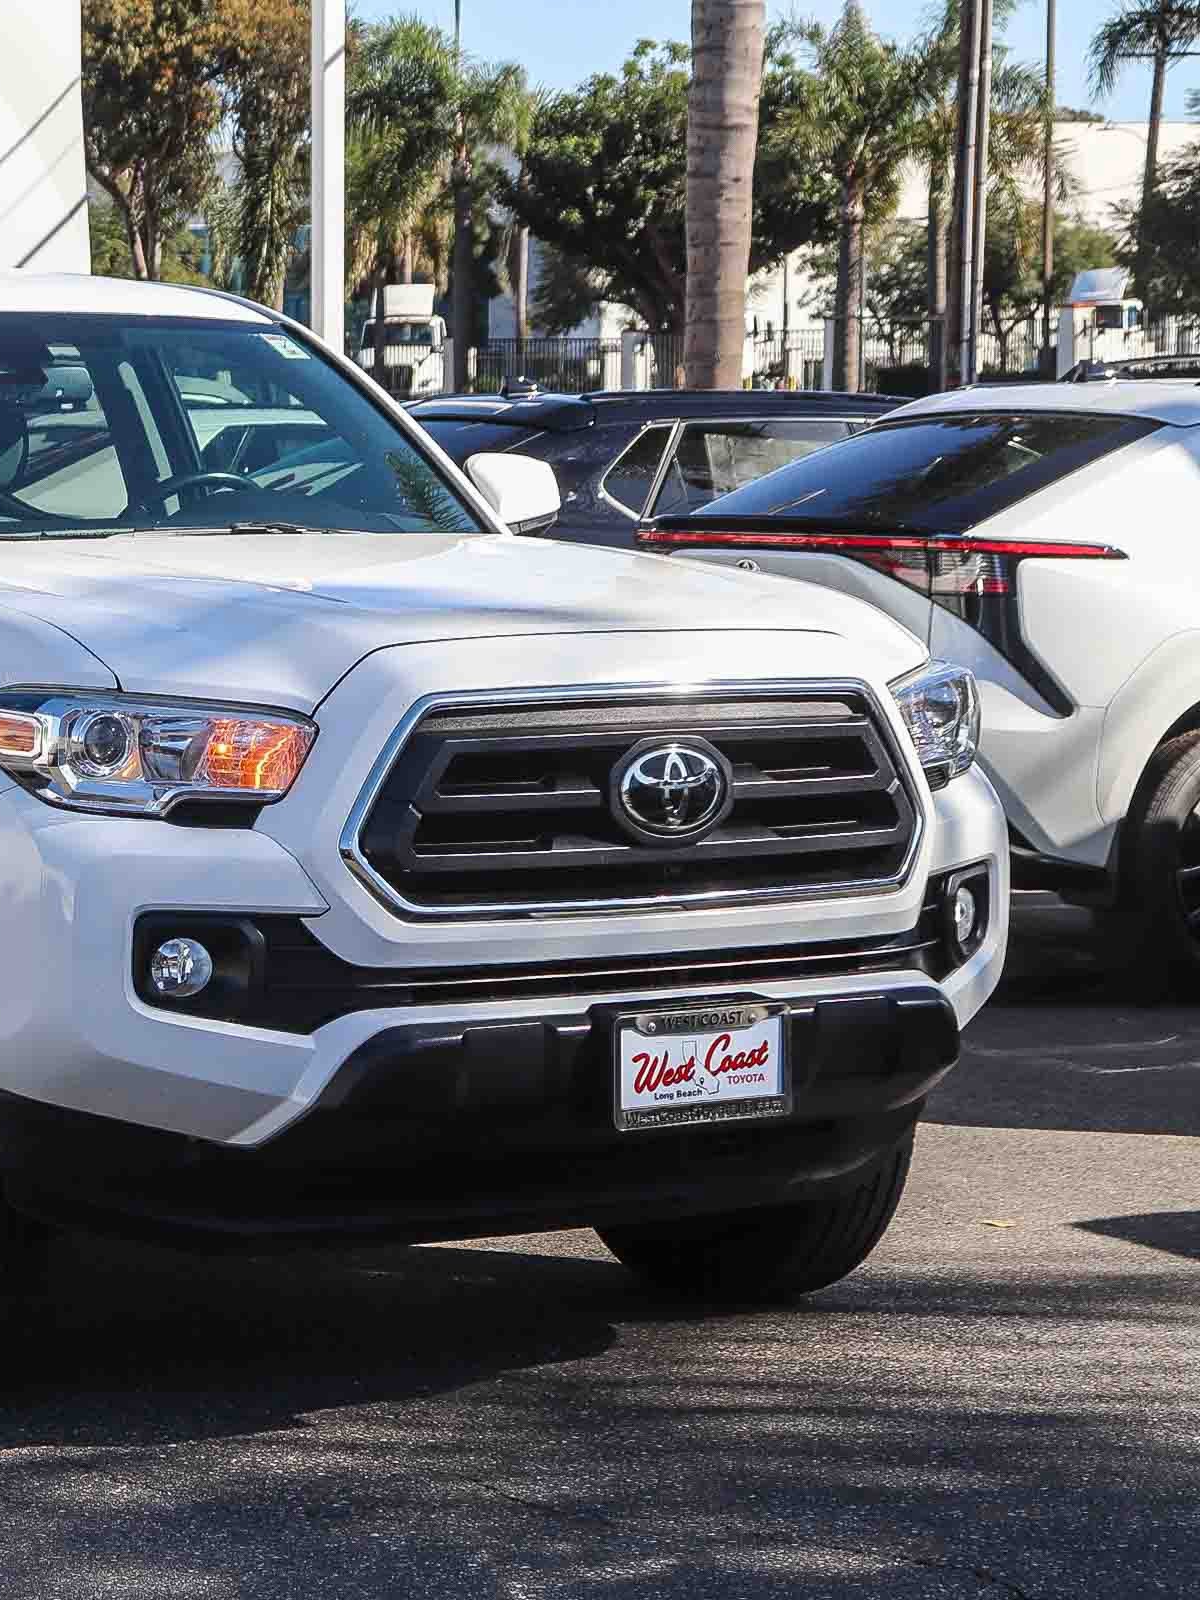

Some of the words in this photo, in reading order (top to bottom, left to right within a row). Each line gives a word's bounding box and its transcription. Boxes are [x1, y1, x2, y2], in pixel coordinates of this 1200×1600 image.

[662, 1014, 698, 1030] WEST
[702, 1010, 744, 1026] COAST
[632, 1050, 696, 1094] West
[704, 1034, 769, 1076] Coast
[727, 1073, 765, 1085] TOYOTA
[654, 1091, 674, 1101] Long
[676, 1088, 703, 1098] Beach
